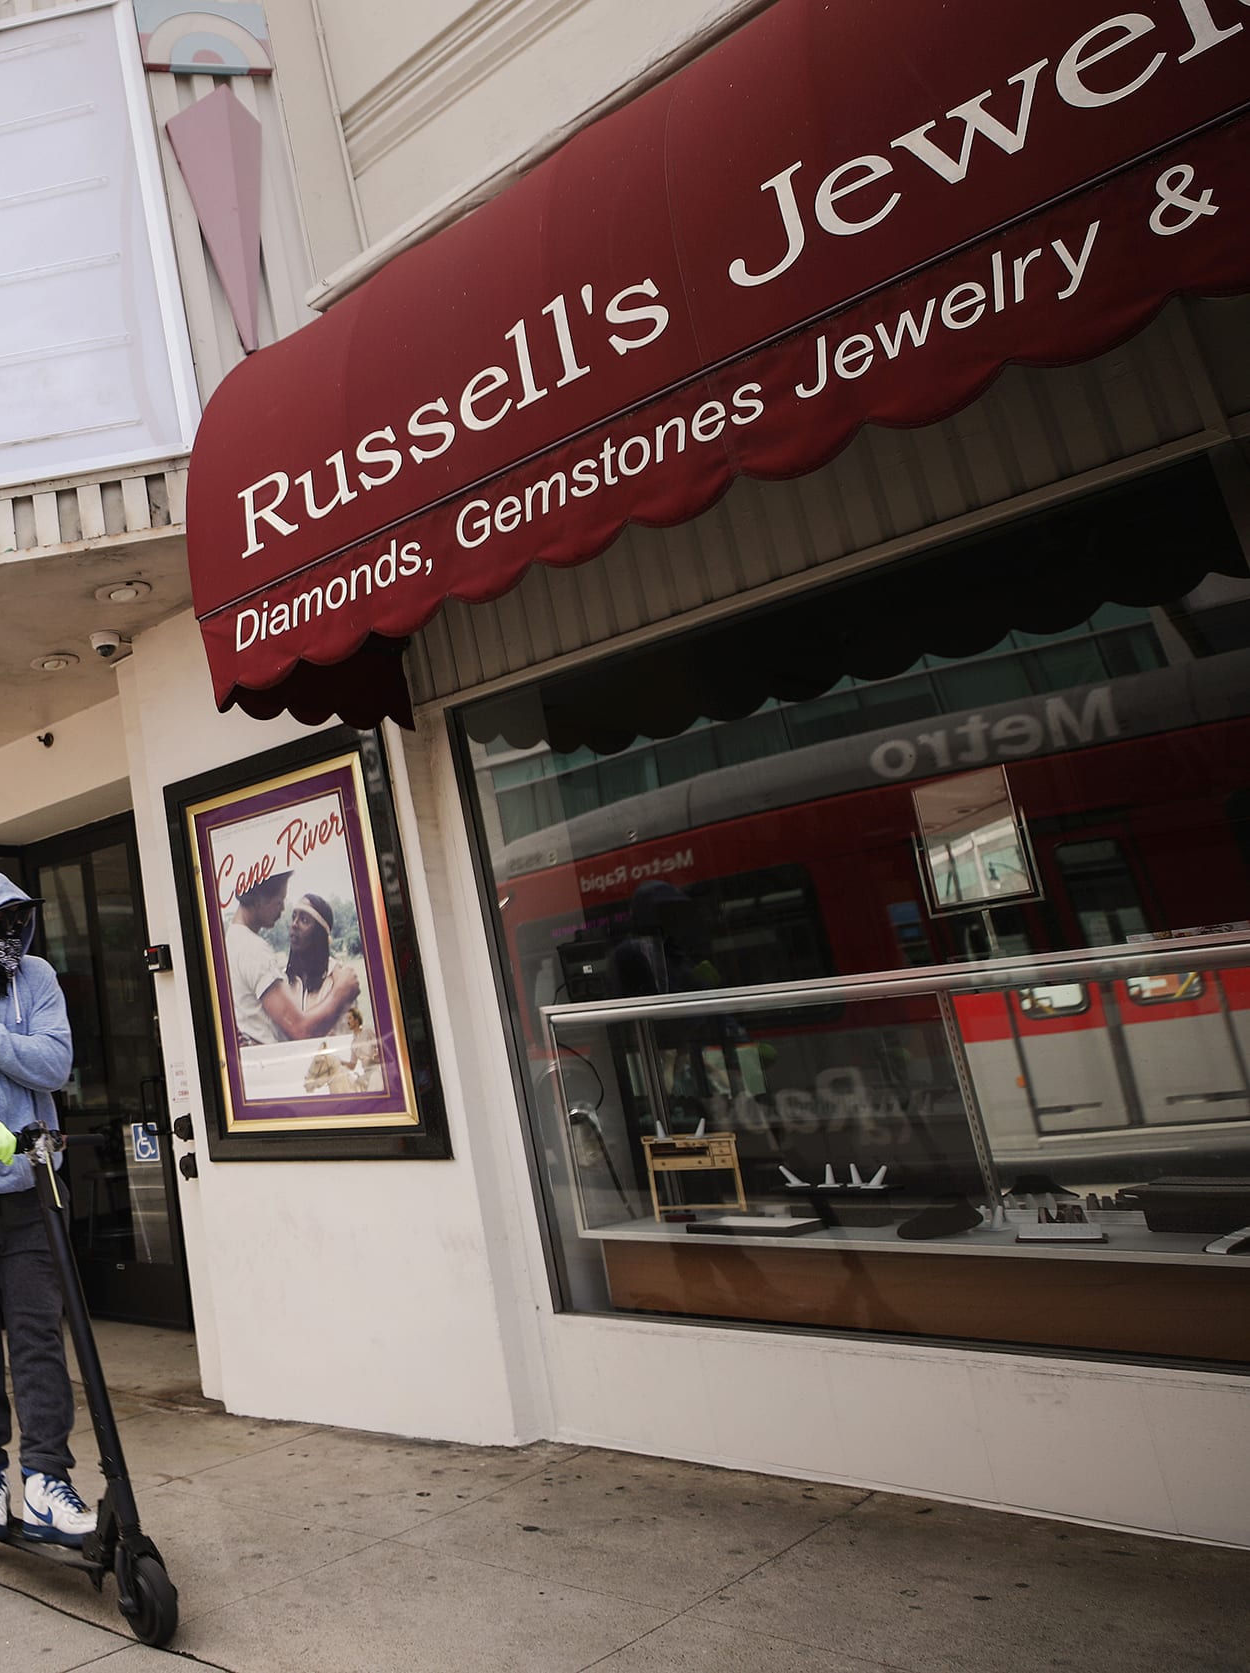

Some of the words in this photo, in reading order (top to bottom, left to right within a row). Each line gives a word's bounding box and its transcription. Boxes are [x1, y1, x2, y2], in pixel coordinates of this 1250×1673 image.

[235, 540, 433, 652] Diamonds,
[456, 382, 764, 549] Gemstones
[795, 220, 1100, 399] Jewelry
[1149, 164, 1219, 235] &
[237, 278, 669, 559] Russell's
[217, 854, 276, 908] Cane
[277, 811, 345, 867] River
